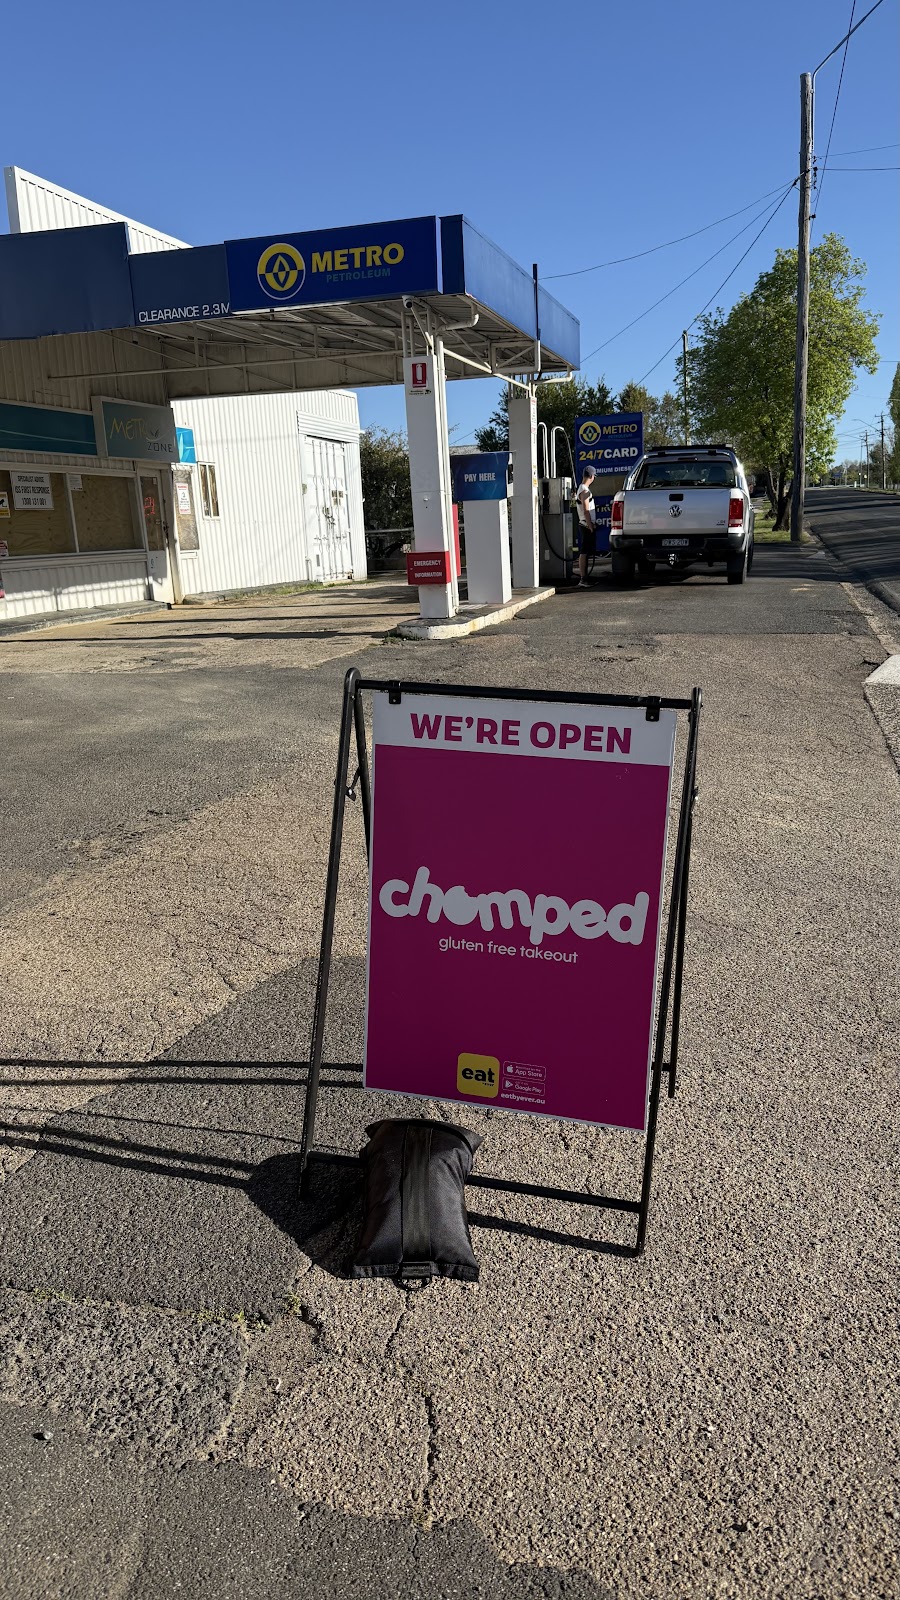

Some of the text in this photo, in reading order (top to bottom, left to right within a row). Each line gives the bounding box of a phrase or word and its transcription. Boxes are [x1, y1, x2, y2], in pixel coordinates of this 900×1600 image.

[311, 243, 404, 273] METRO
[326, 268, 391, 283] PETROLEUM
[138, 306, 200, 322] CLEARANCE
[602, 424, 638, 434] METRO
[147, 442, 173, 453] ZONE
[579, 447, 638, 461] 24/7CARD
[464, 472, 496, 483] PAY HERE
[413, 558, 442, 567] EMERGENCY
[410, 713, 632, 754] WE’RE OPEN
[378, 865, 649, 946] chomped
[438, 936, 578, 964] gluten free takeout
[461, 1067, 495, 1084] eat
[527, 1069, 543, 1077] Store
[514, 1084, 532, 1092] Google
[500, 1093, 546, 1104] eatbyever.au
